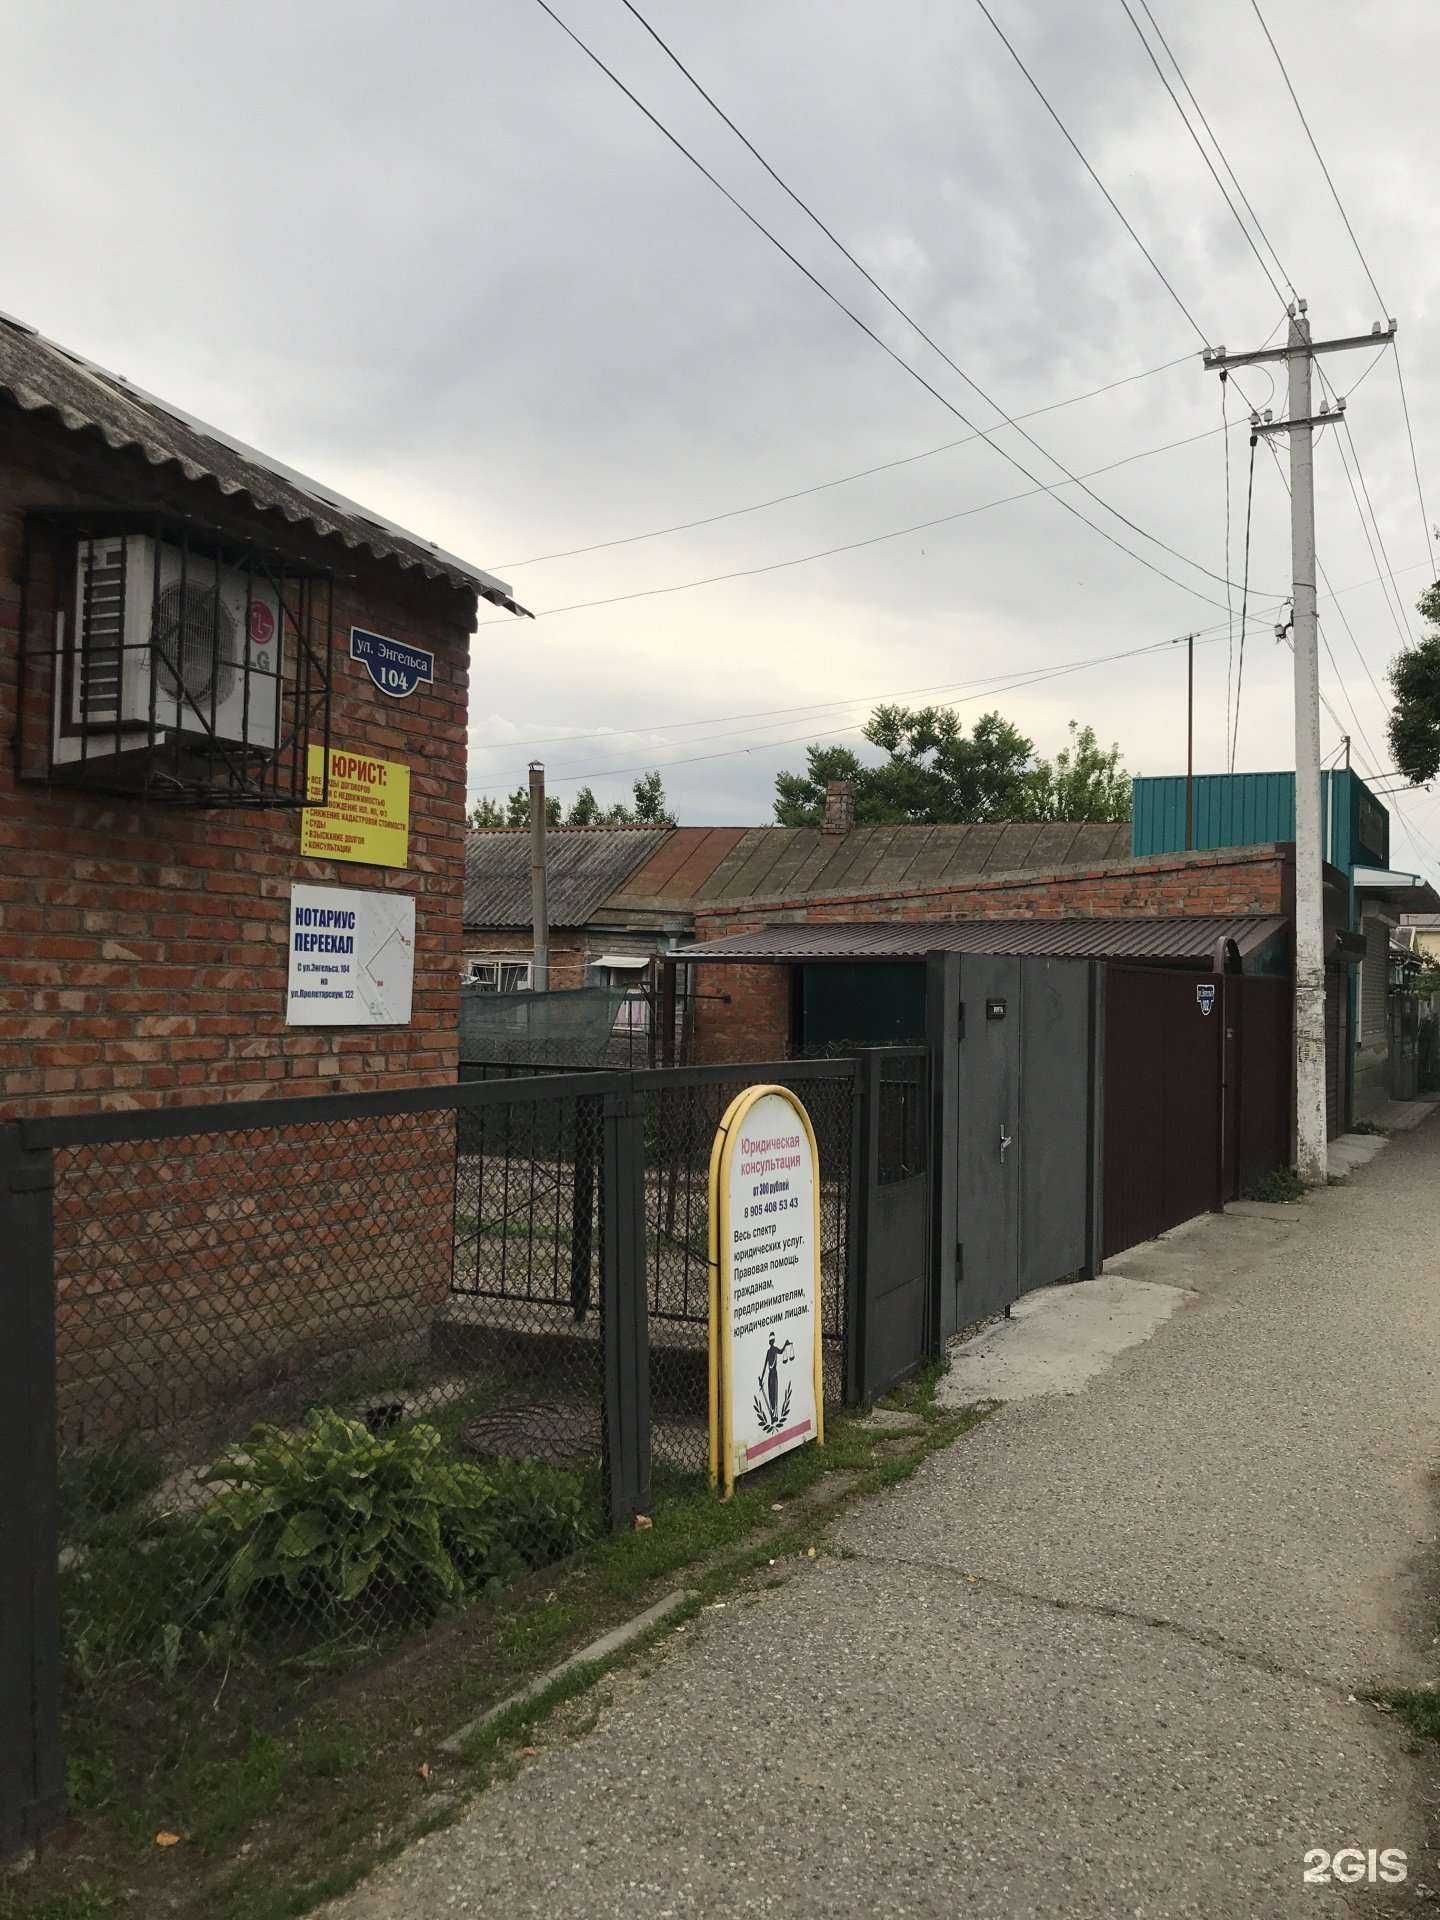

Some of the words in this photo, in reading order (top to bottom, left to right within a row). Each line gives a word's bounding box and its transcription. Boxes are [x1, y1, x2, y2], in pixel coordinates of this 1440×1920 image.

[357, 640, 374, 655] ул.
[378, 643, 428, 671] Энгельса
[381, 667, 408, 690] 104
[331, 754, 387, 786] ЮРИСТ:
[309, 819, 326, 829] СУДЫ
[295, 906, 355, 930] НОТАРИУС
[294, 932, 354, 955] ПЕРЕЕХАЛ
[741, 1135, 800, 1157] Юридическая
[741, 1155, 801, 1177] консультация
[752, 1186, 759, 1197] от
[770, 1178, 790, 1195] рублей
[744, 1207, 749, 1218] 8
[750, 1204, 763, 1217] 905
[779, 1199, 788, 1211] 53
[789, 1197, 799, 1209] 43
[734, 1230, 751, 1243] Весь
[753, 1224, 777, 1238] спектр
[734, 1241, 781, 1262] юридических
[734, 1262, 768, 1282] Правовая
[769, 1255, 799, 1271] помощь
[734, 1312, 783, 1338] юридическим
[784, 1304, 810, 1320] лицам.
